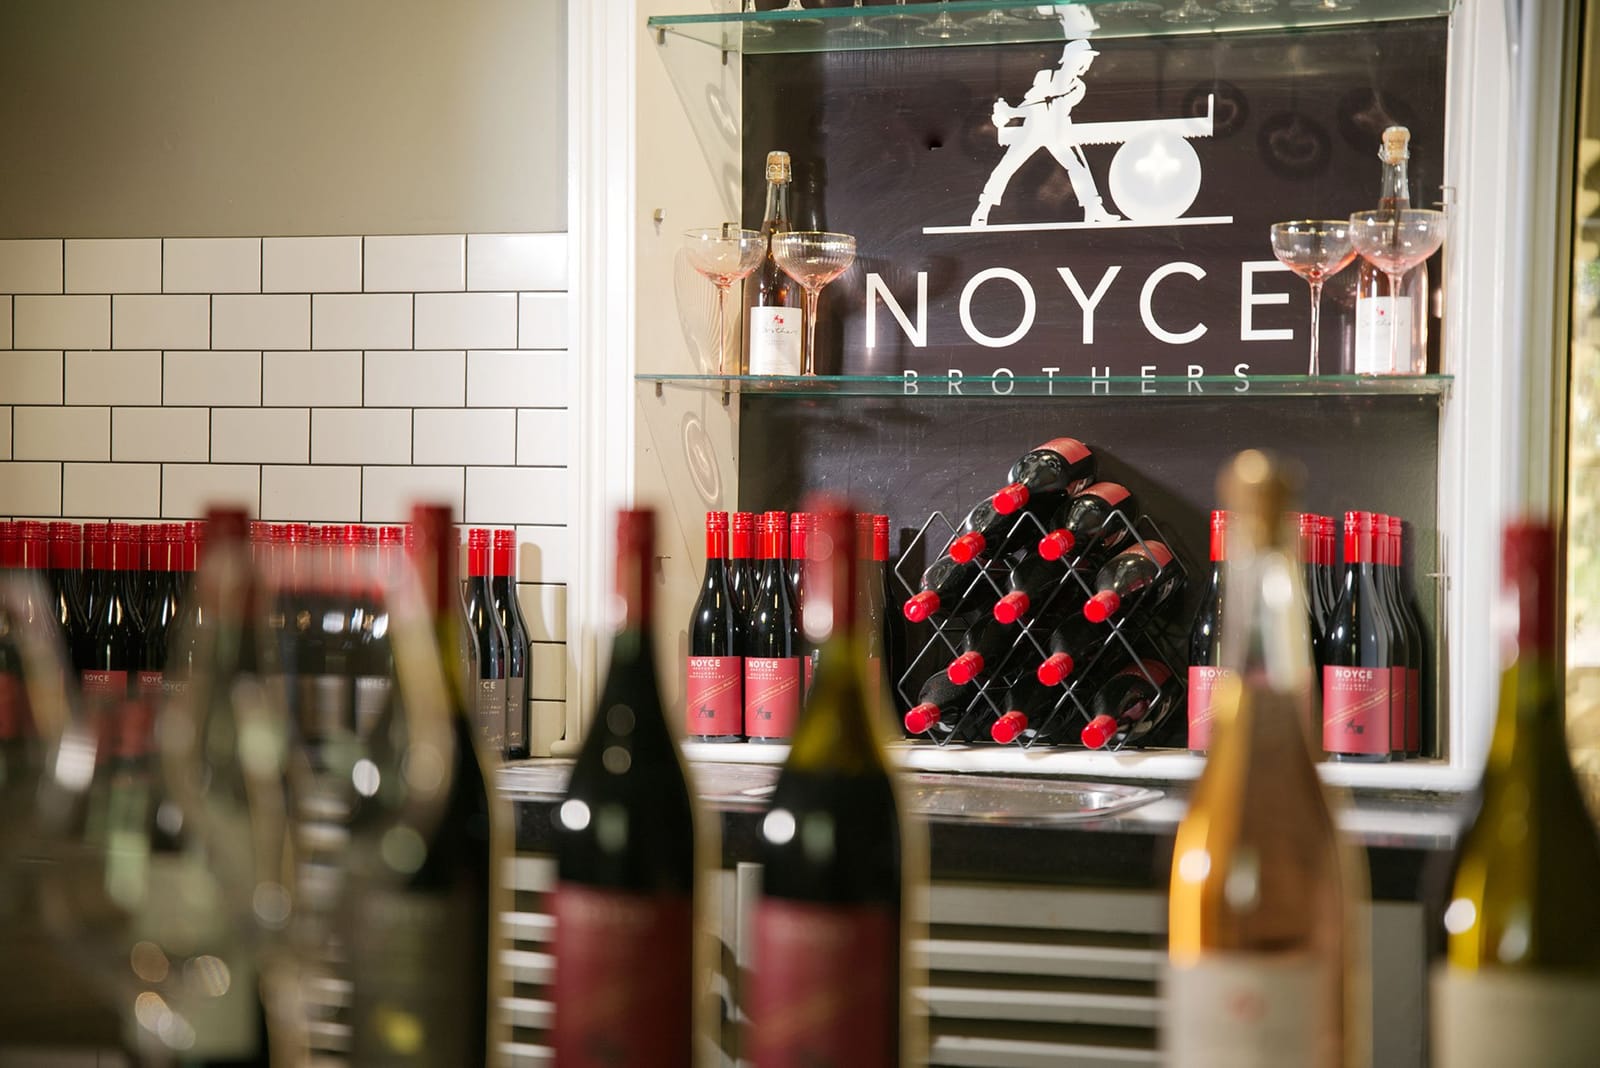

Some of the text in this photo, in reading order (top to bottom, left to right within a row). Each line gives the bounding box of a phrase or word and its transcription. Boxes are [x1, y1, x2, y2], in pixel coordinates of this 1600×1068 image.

[865, 261, 1294, 349] NOYCE
[903, 363, 1251, 395] BROTHERS
[691, 659, 721, 668] NOYCE
[748, 660, 778, 669] NOYCE
[1199, 669, 1230, 678] NOYC
[1335, 670, 1373, 680] NOYCE
[142, 675, 163, 684] NOYC
